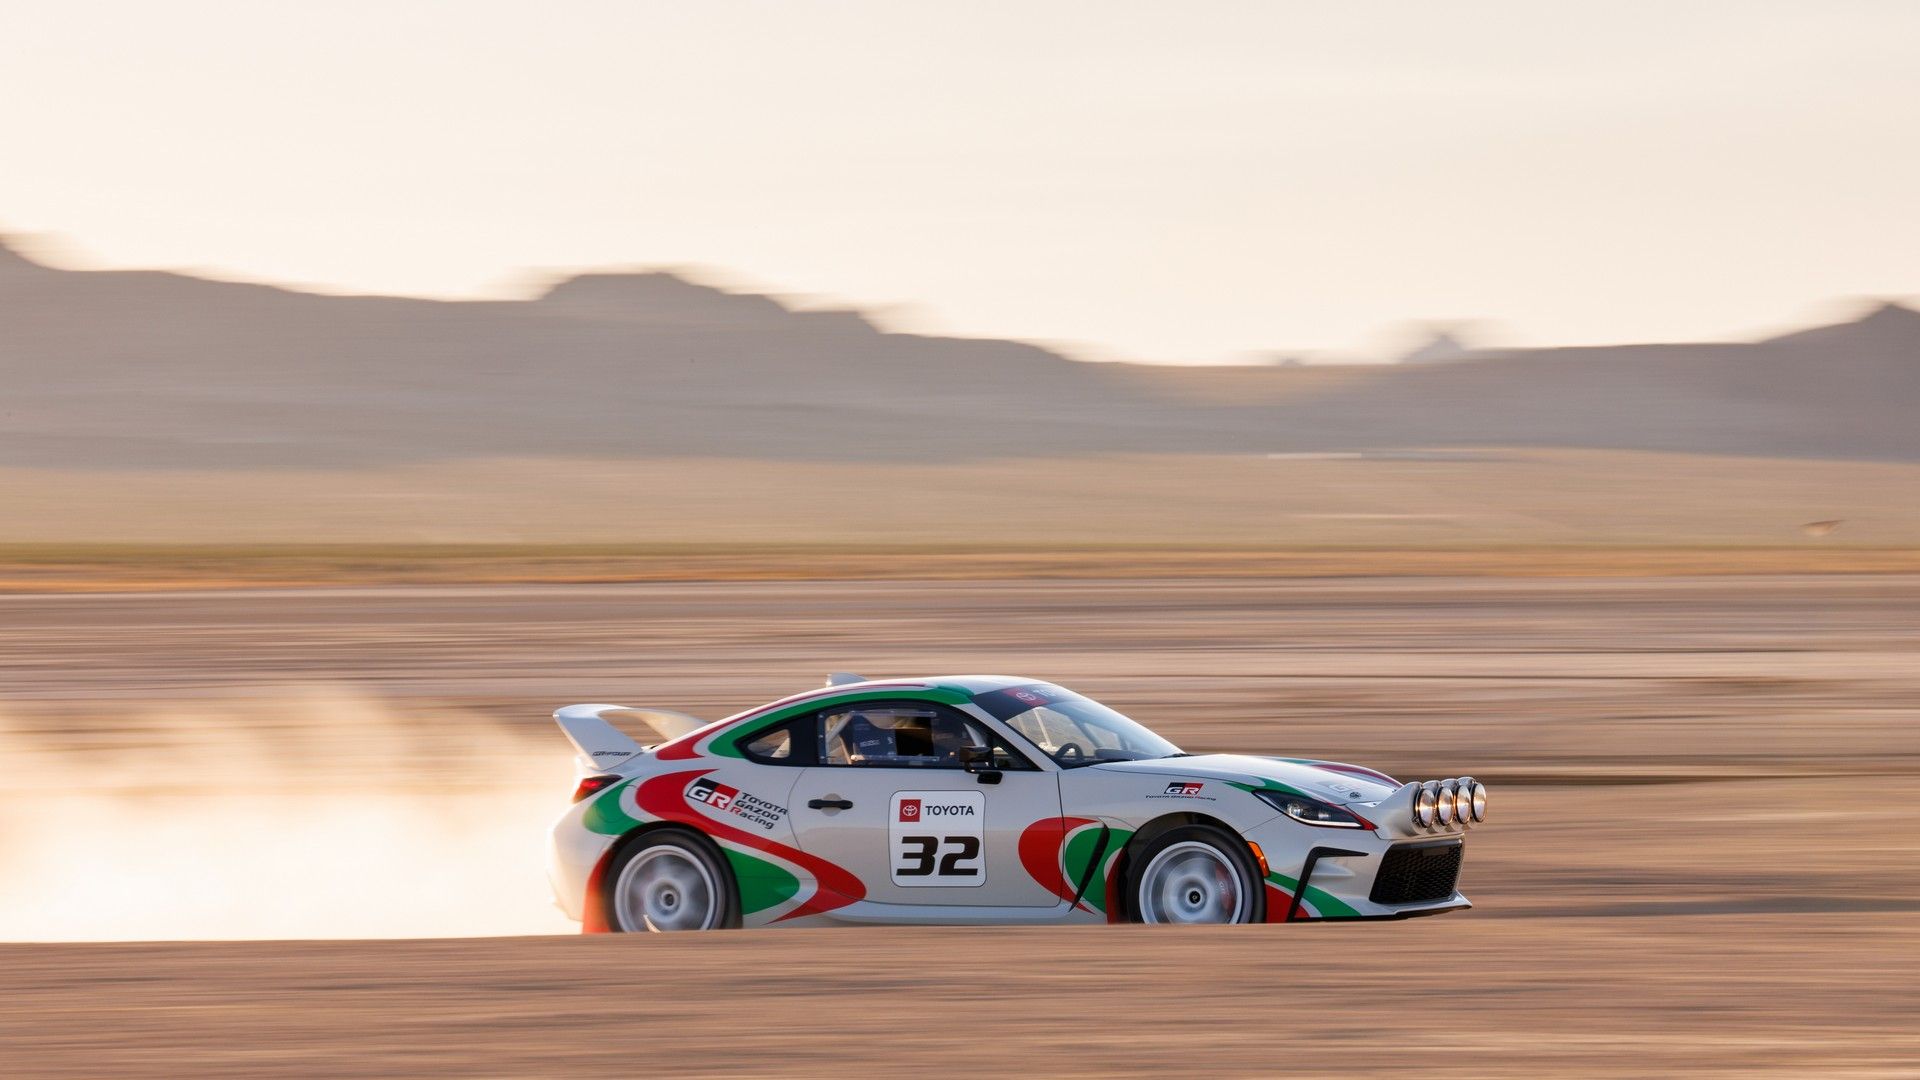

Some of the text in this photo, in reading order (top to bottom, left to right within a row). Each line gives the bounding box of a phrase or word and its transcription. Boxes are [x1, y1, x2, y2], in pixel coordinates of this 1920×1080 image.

[688, 786, 731, 810] GR
[1165, 786, 1200, 795] GR
[734, 800, 780, 821] GAZOO
[741, 792, 788, 815] TOYOTA
[925, 805, 975, 816] TOYOTA
[729, 806, 775, 830] Racing
[896, 836, 980, 876] 32
